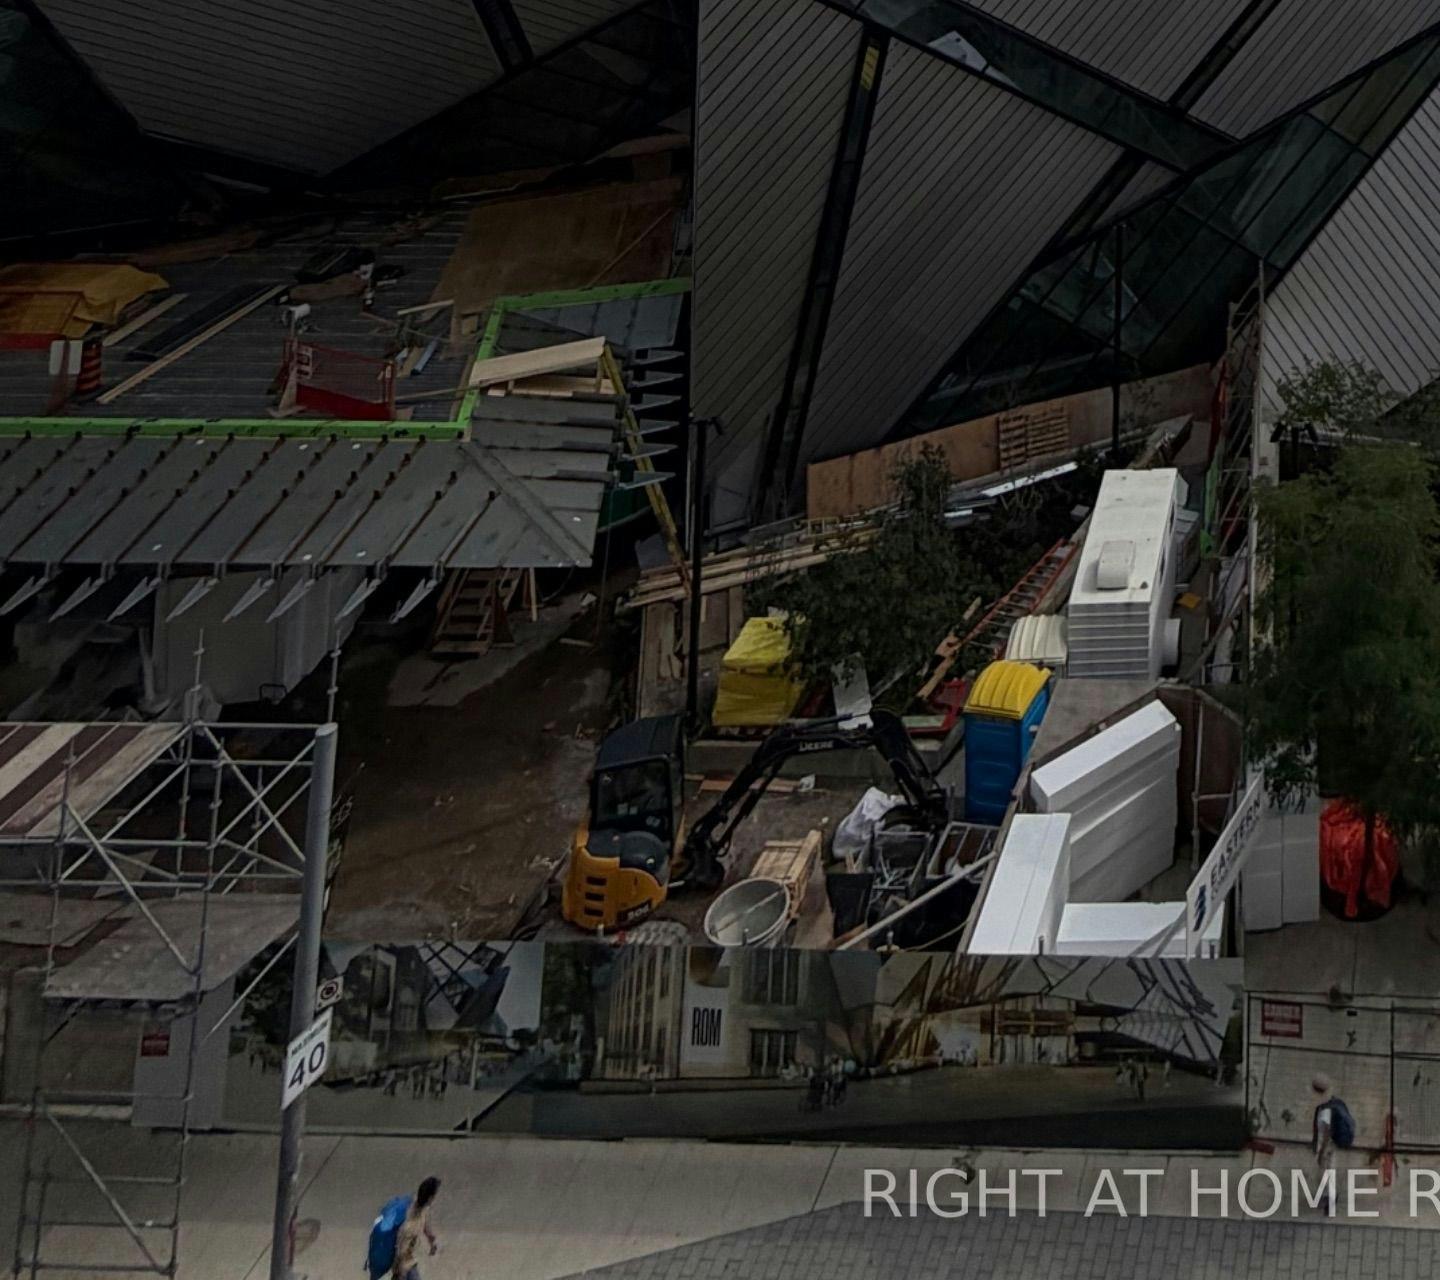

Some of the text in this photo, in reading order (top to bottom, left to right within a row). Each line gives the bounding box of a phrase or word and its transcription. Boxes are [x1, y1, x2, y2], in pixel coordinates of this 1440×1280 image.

[1209, 794, 1261, 886] EASTERN
[691, 1007, 722, 1046] ROM
[288, 1041, 325, 1088] 40
